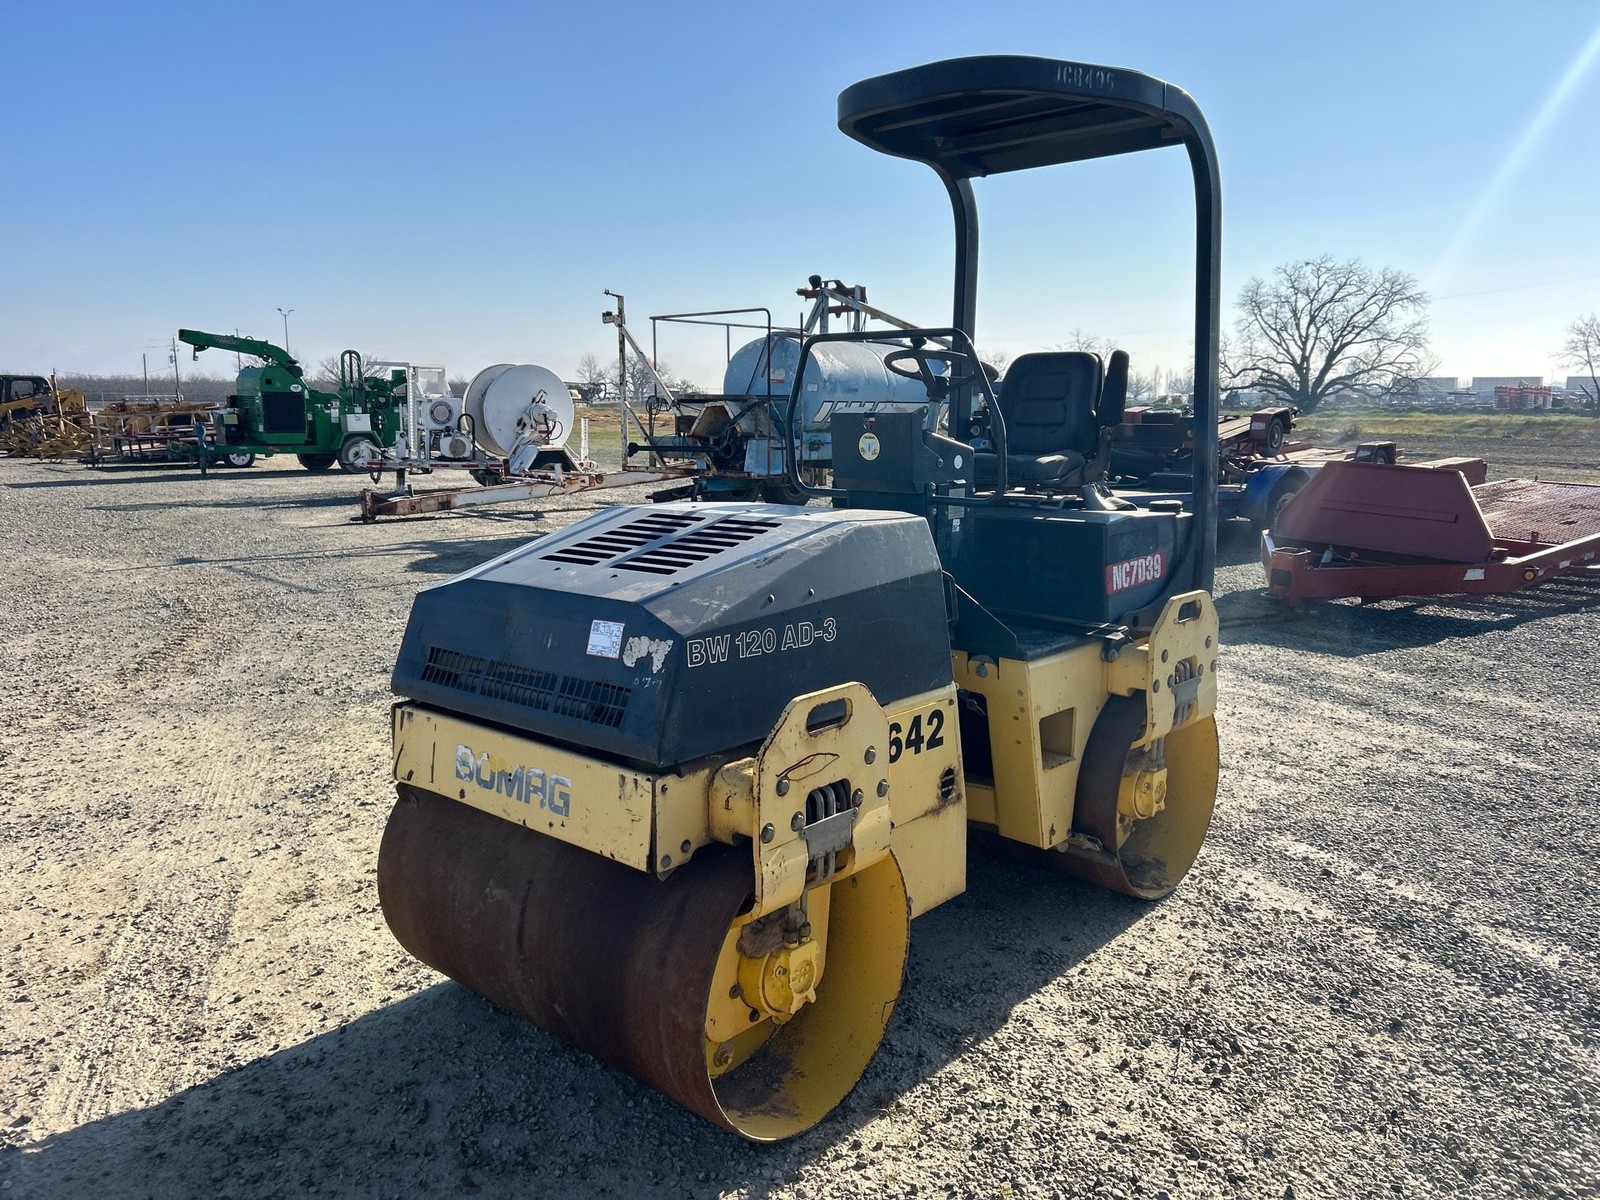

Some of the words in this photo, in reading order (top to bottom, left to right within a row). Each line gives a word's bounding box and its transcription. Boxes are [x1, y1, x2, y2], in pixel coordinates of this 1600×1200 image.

[1112, 553, 1161, 591] NC7D39
[687, 635, 731, 668] BW
[735, 628, 777, 659] 120
[781, 617, 837, 651] AD-3
[889, 709, 944, 764] 642
[455, 744, 572, 817] BOMAG
